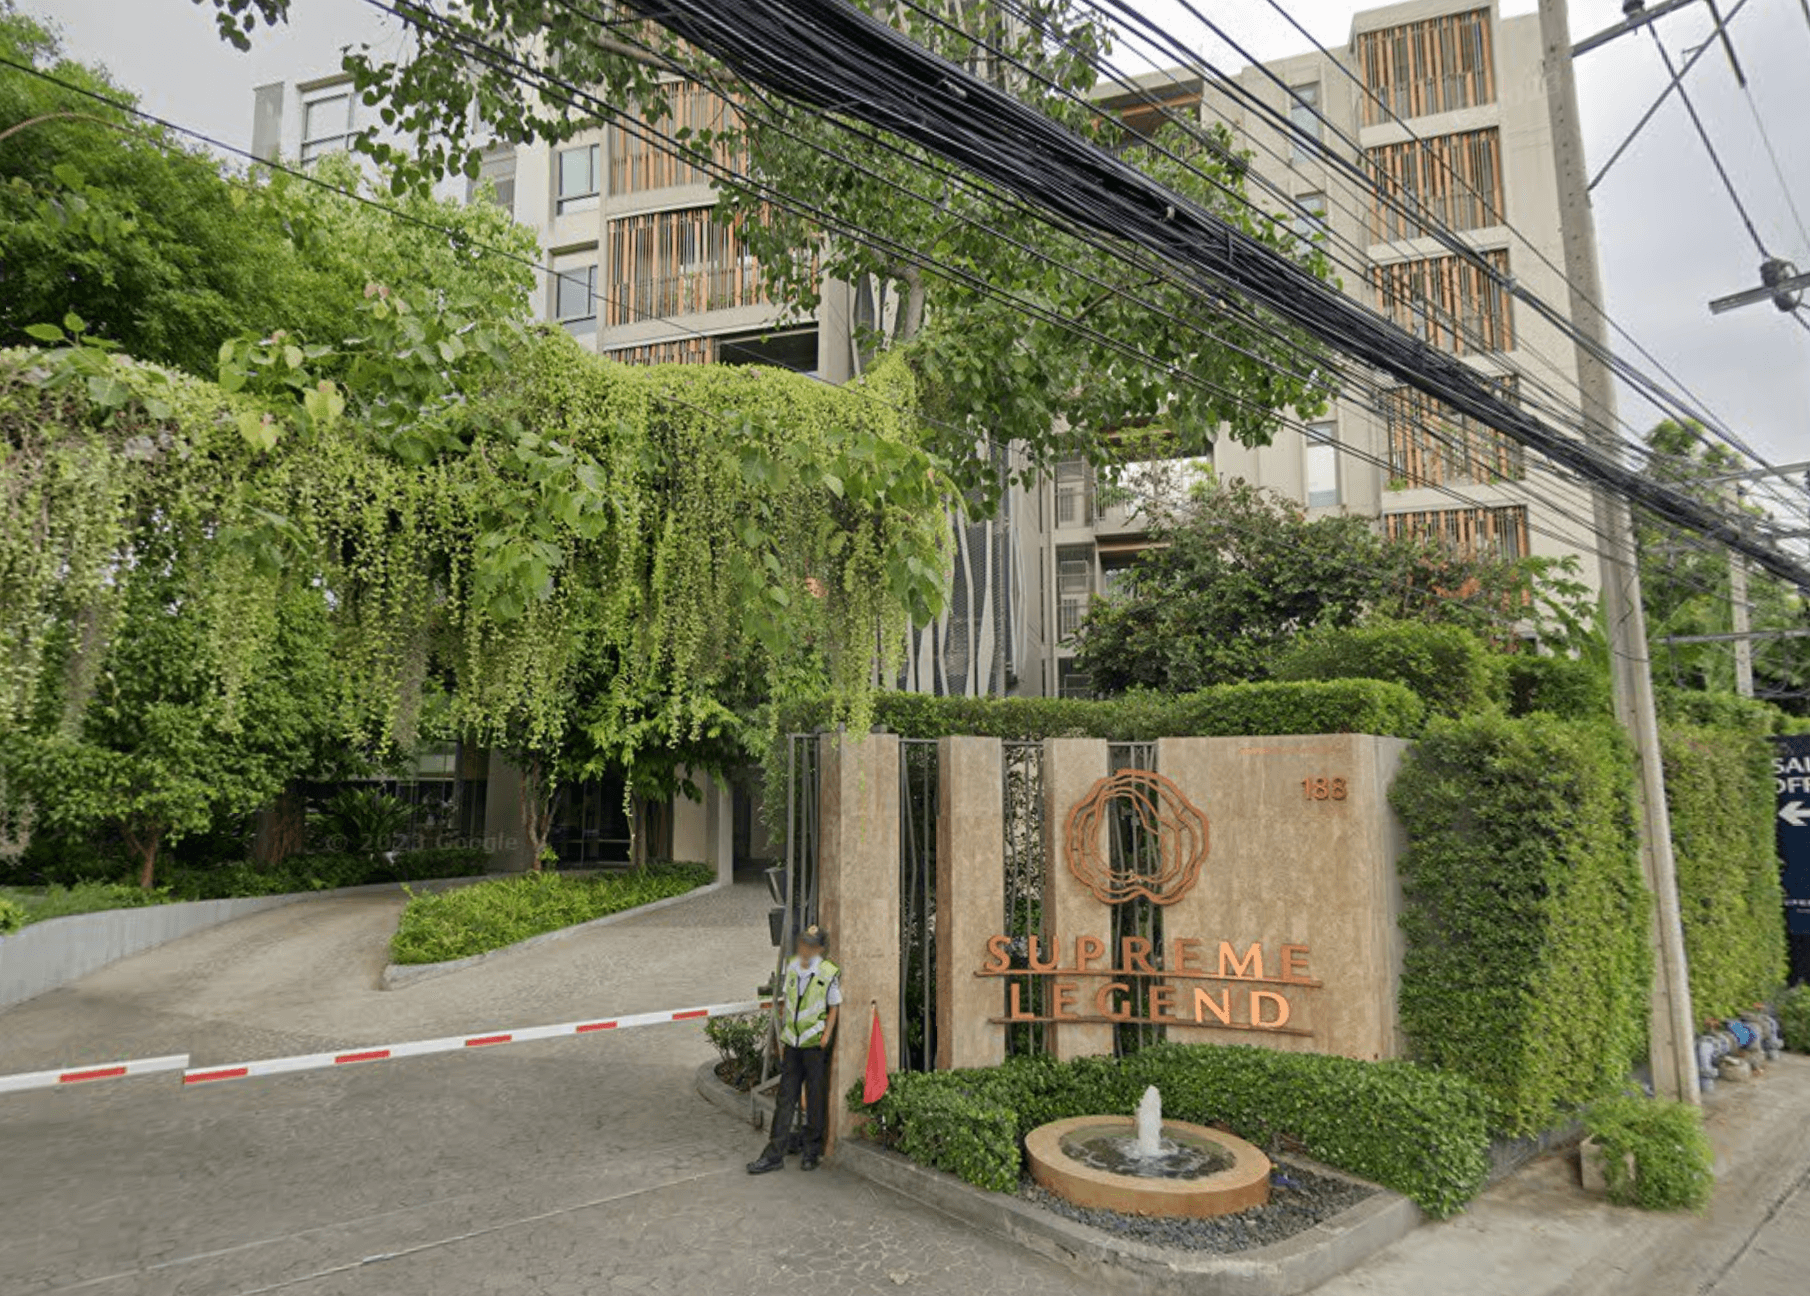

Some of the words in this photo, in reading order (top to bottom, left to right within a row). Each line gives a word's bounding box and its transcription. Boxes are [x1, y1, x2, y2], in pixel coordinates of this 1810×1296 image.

[1301, 777, 1348, 801] 188
[982, 934, 1312, 984] SUPREME
[1010, 982, 1290, 1029] LEGEND
